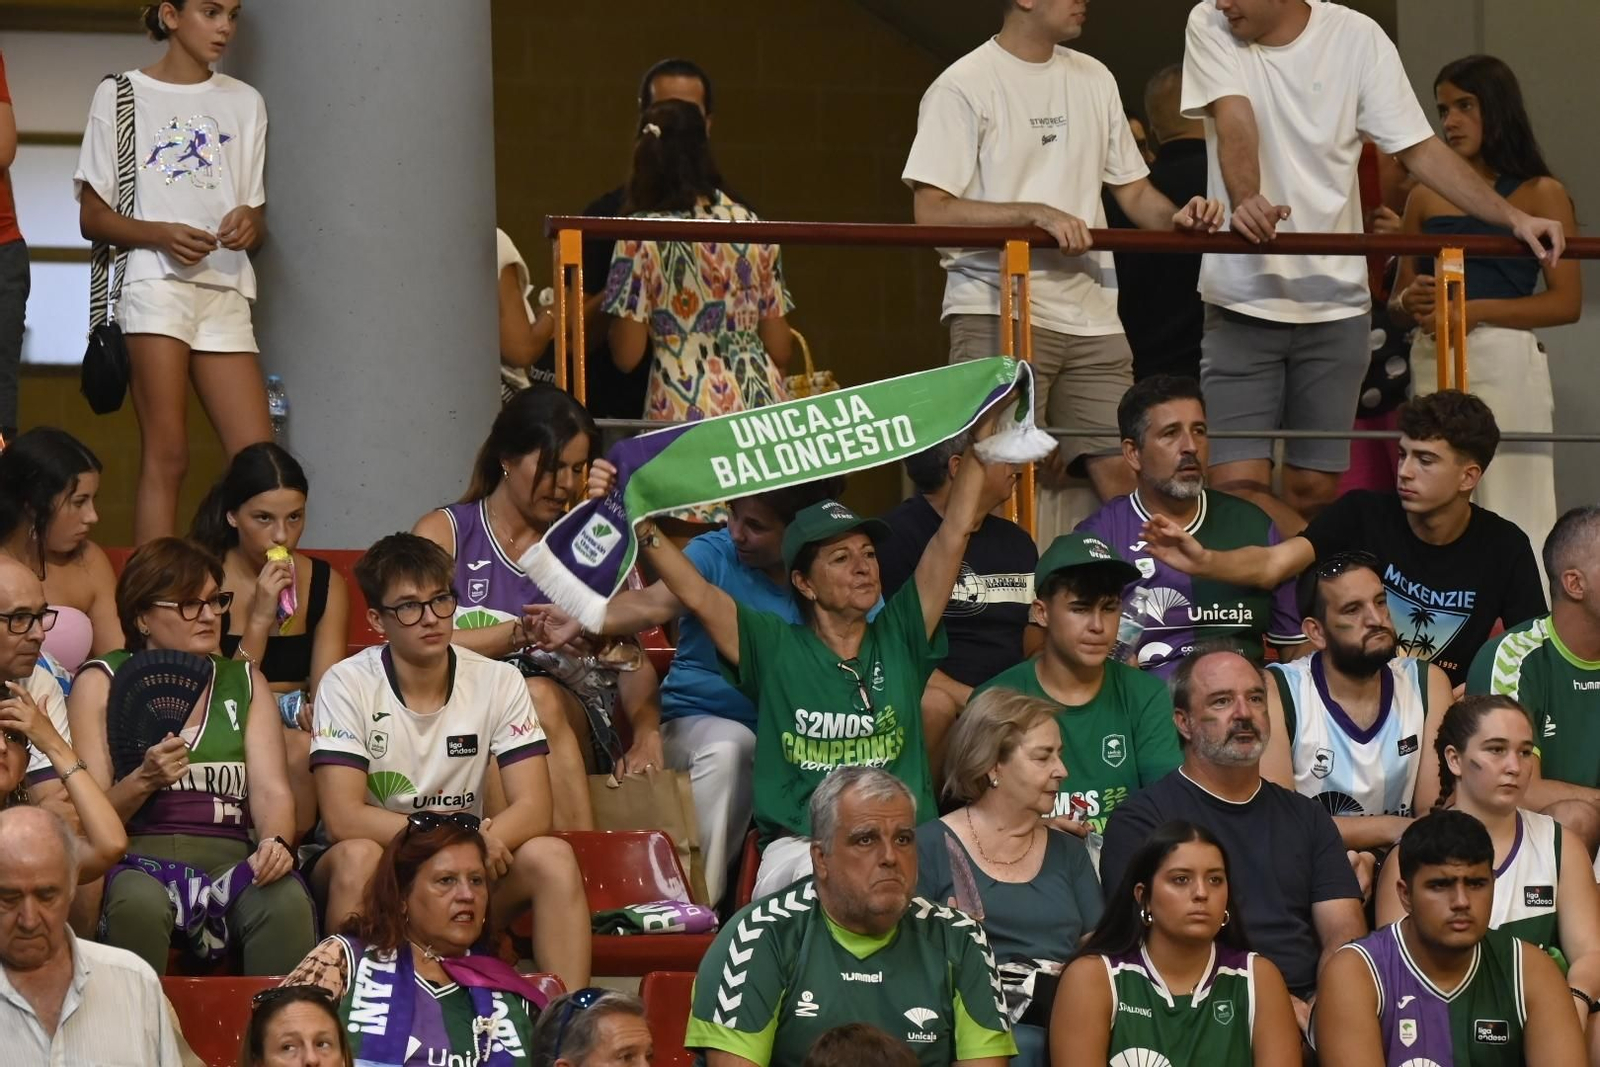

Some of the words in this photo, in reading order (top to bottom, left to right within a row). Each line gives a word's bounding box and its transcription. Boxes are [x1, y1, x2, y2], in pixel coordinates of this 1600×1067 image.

[729, 394, 875, 448] UNICAJA
[710, 415, 916, 489] BALONCESTO
[1187, 603, 1253, 623] Unicaja
[1438, 660, 1458, 670] 1992
[449, 741, 462, 749] liga
[450, 747, 476, 755] endesa
[781, 727, 904, 766] CAMPEONES
[412, 788, 475, 809] Unicaja
[1526, 892, 1539, 900] liga
[347, 957, 397, 1036] LAN!
[1118, 1001, 1152, 1018] SPALDING
[907, 1031, 937, 1043] Unicaja
[1478, 1027, 1492, 1035] liga
